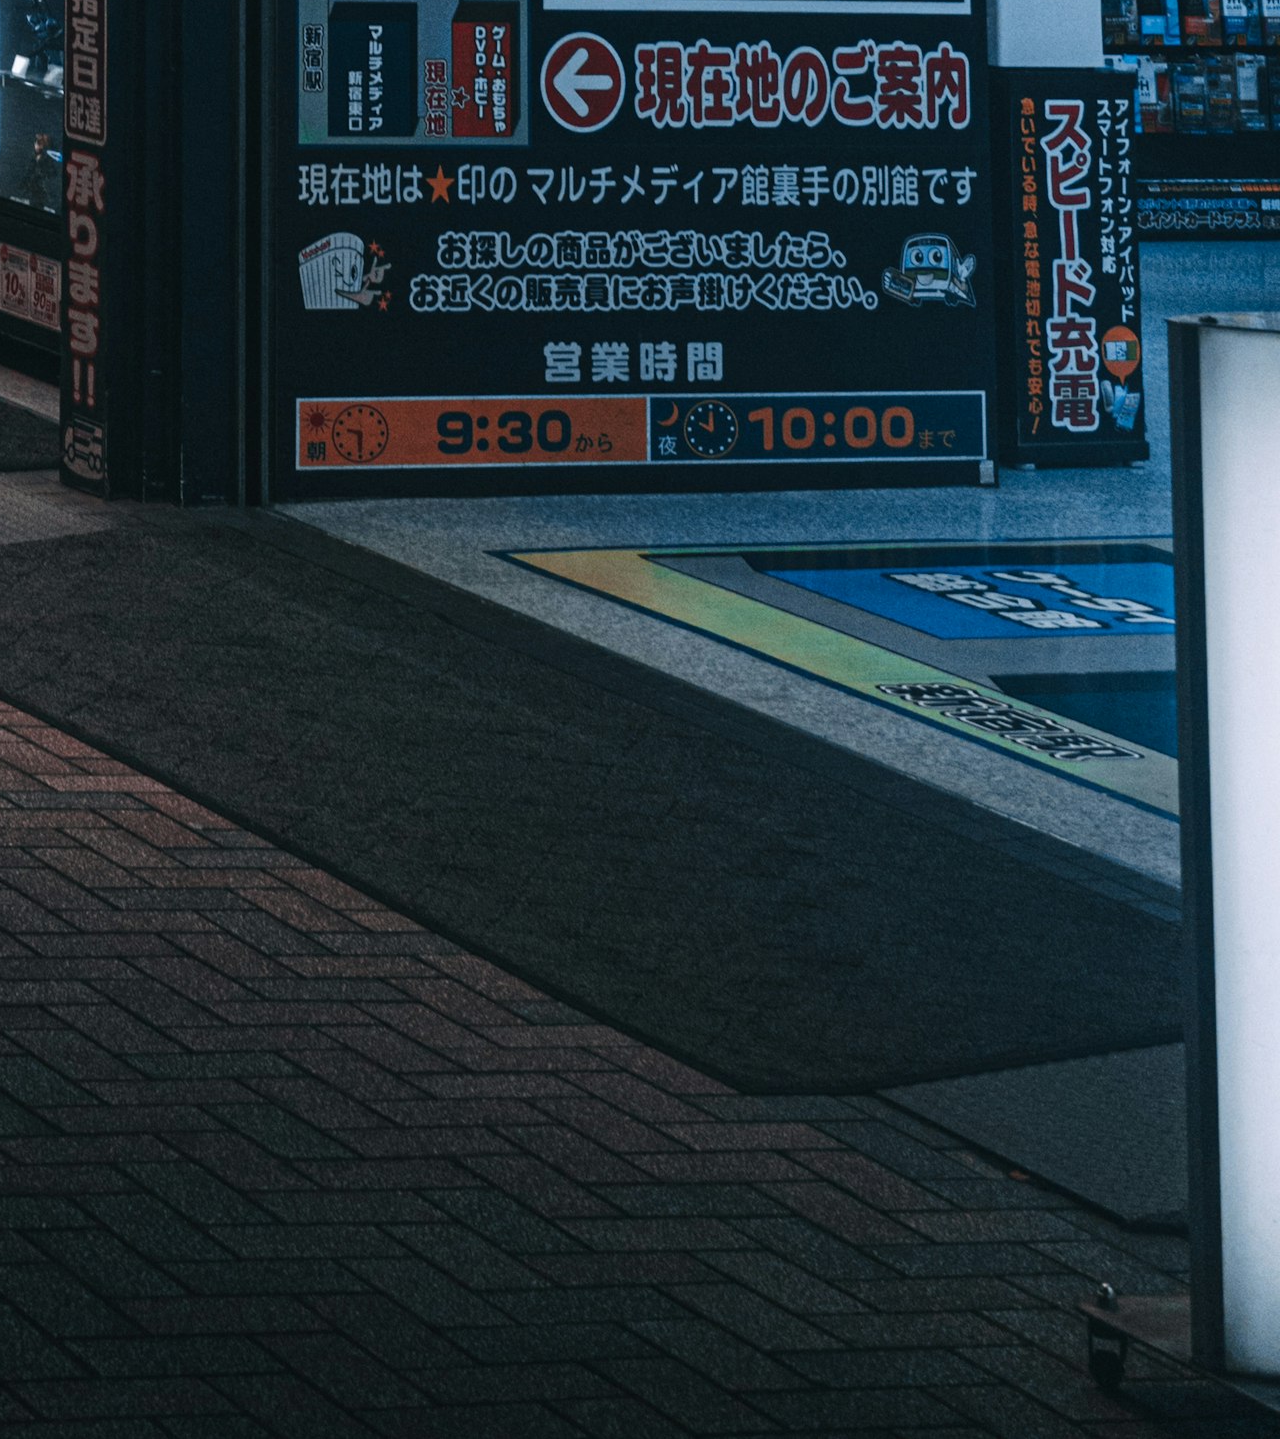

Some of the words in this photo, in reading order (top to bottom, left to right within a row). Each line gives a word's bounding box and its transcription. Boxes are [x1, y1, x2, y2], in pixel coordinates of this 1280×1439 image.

[303, 23, 324, 93] 新宿駅
[368, 24, 384, 131] マルチメディア
[474, 25, 489, 119] DVD・ホビー
[491, 25, 507, 133] ゲーム・おもちゃ
[634, 39, 972, 130] 現在地のご案内
[348, 70, 363, 132] 新宿東口
[425, 58, 447, 137] 現在地
[1096, 98, 1119, 275] スマートフォン対応
[436, 230, 848, 270] お探しの商品がございましたら、
[1040, 98, 1100, 433] スピード充電
[409, 274, 879, 312] お近くの販売員にお声掛けください。
[542, 340, 725, 383] 営業時間
[306, 439, 327, 463] 朝
[657, 434, 679, 457] 夜
